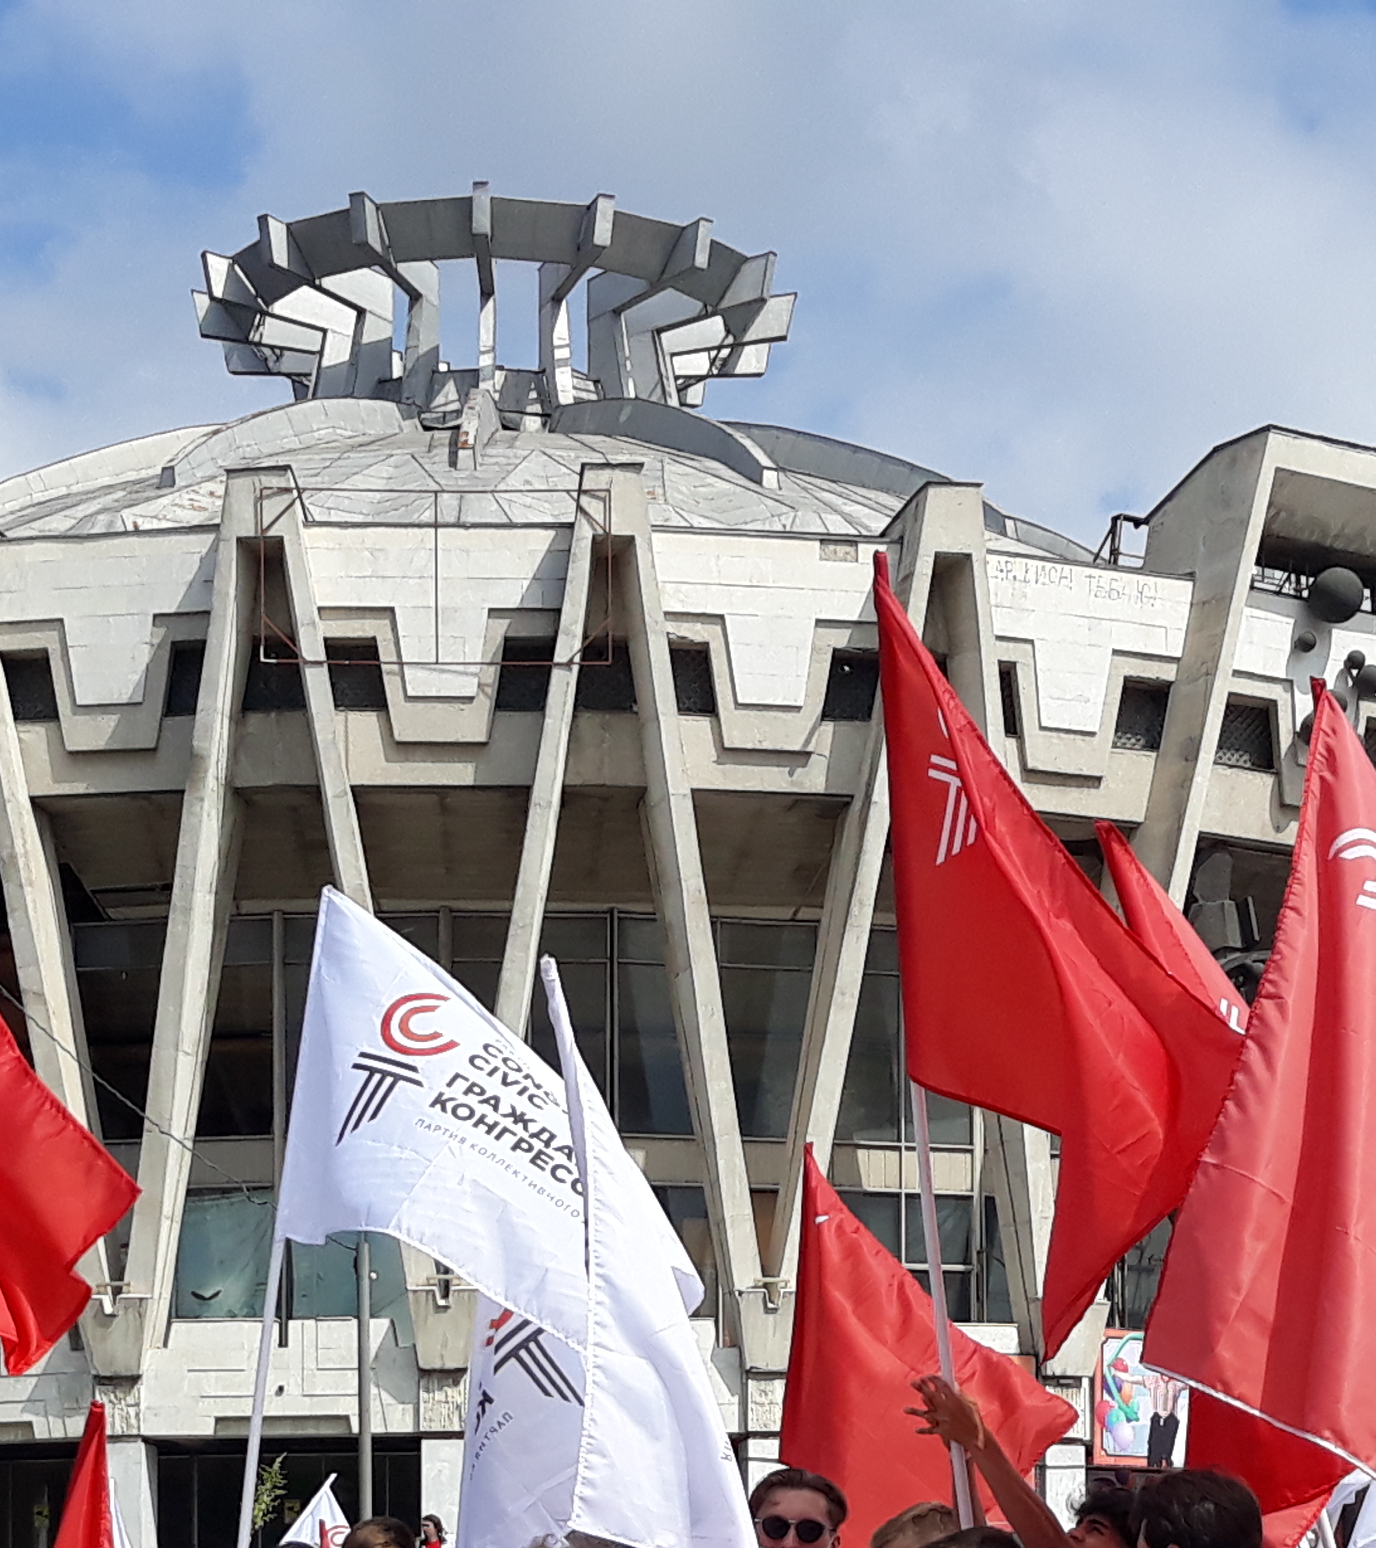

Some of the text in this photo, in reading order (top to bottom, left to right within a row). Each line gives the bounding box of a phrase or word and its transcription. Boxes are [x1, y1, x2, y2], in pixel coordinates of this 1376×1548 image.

[445, 1071, 578, 1166] ГРАЖДА
[468, 1054, 550, 1111] CIVIC
[414, 1117, 581, 1219] ПАРТИЯ КОЛЛЕКТИВНОГО
